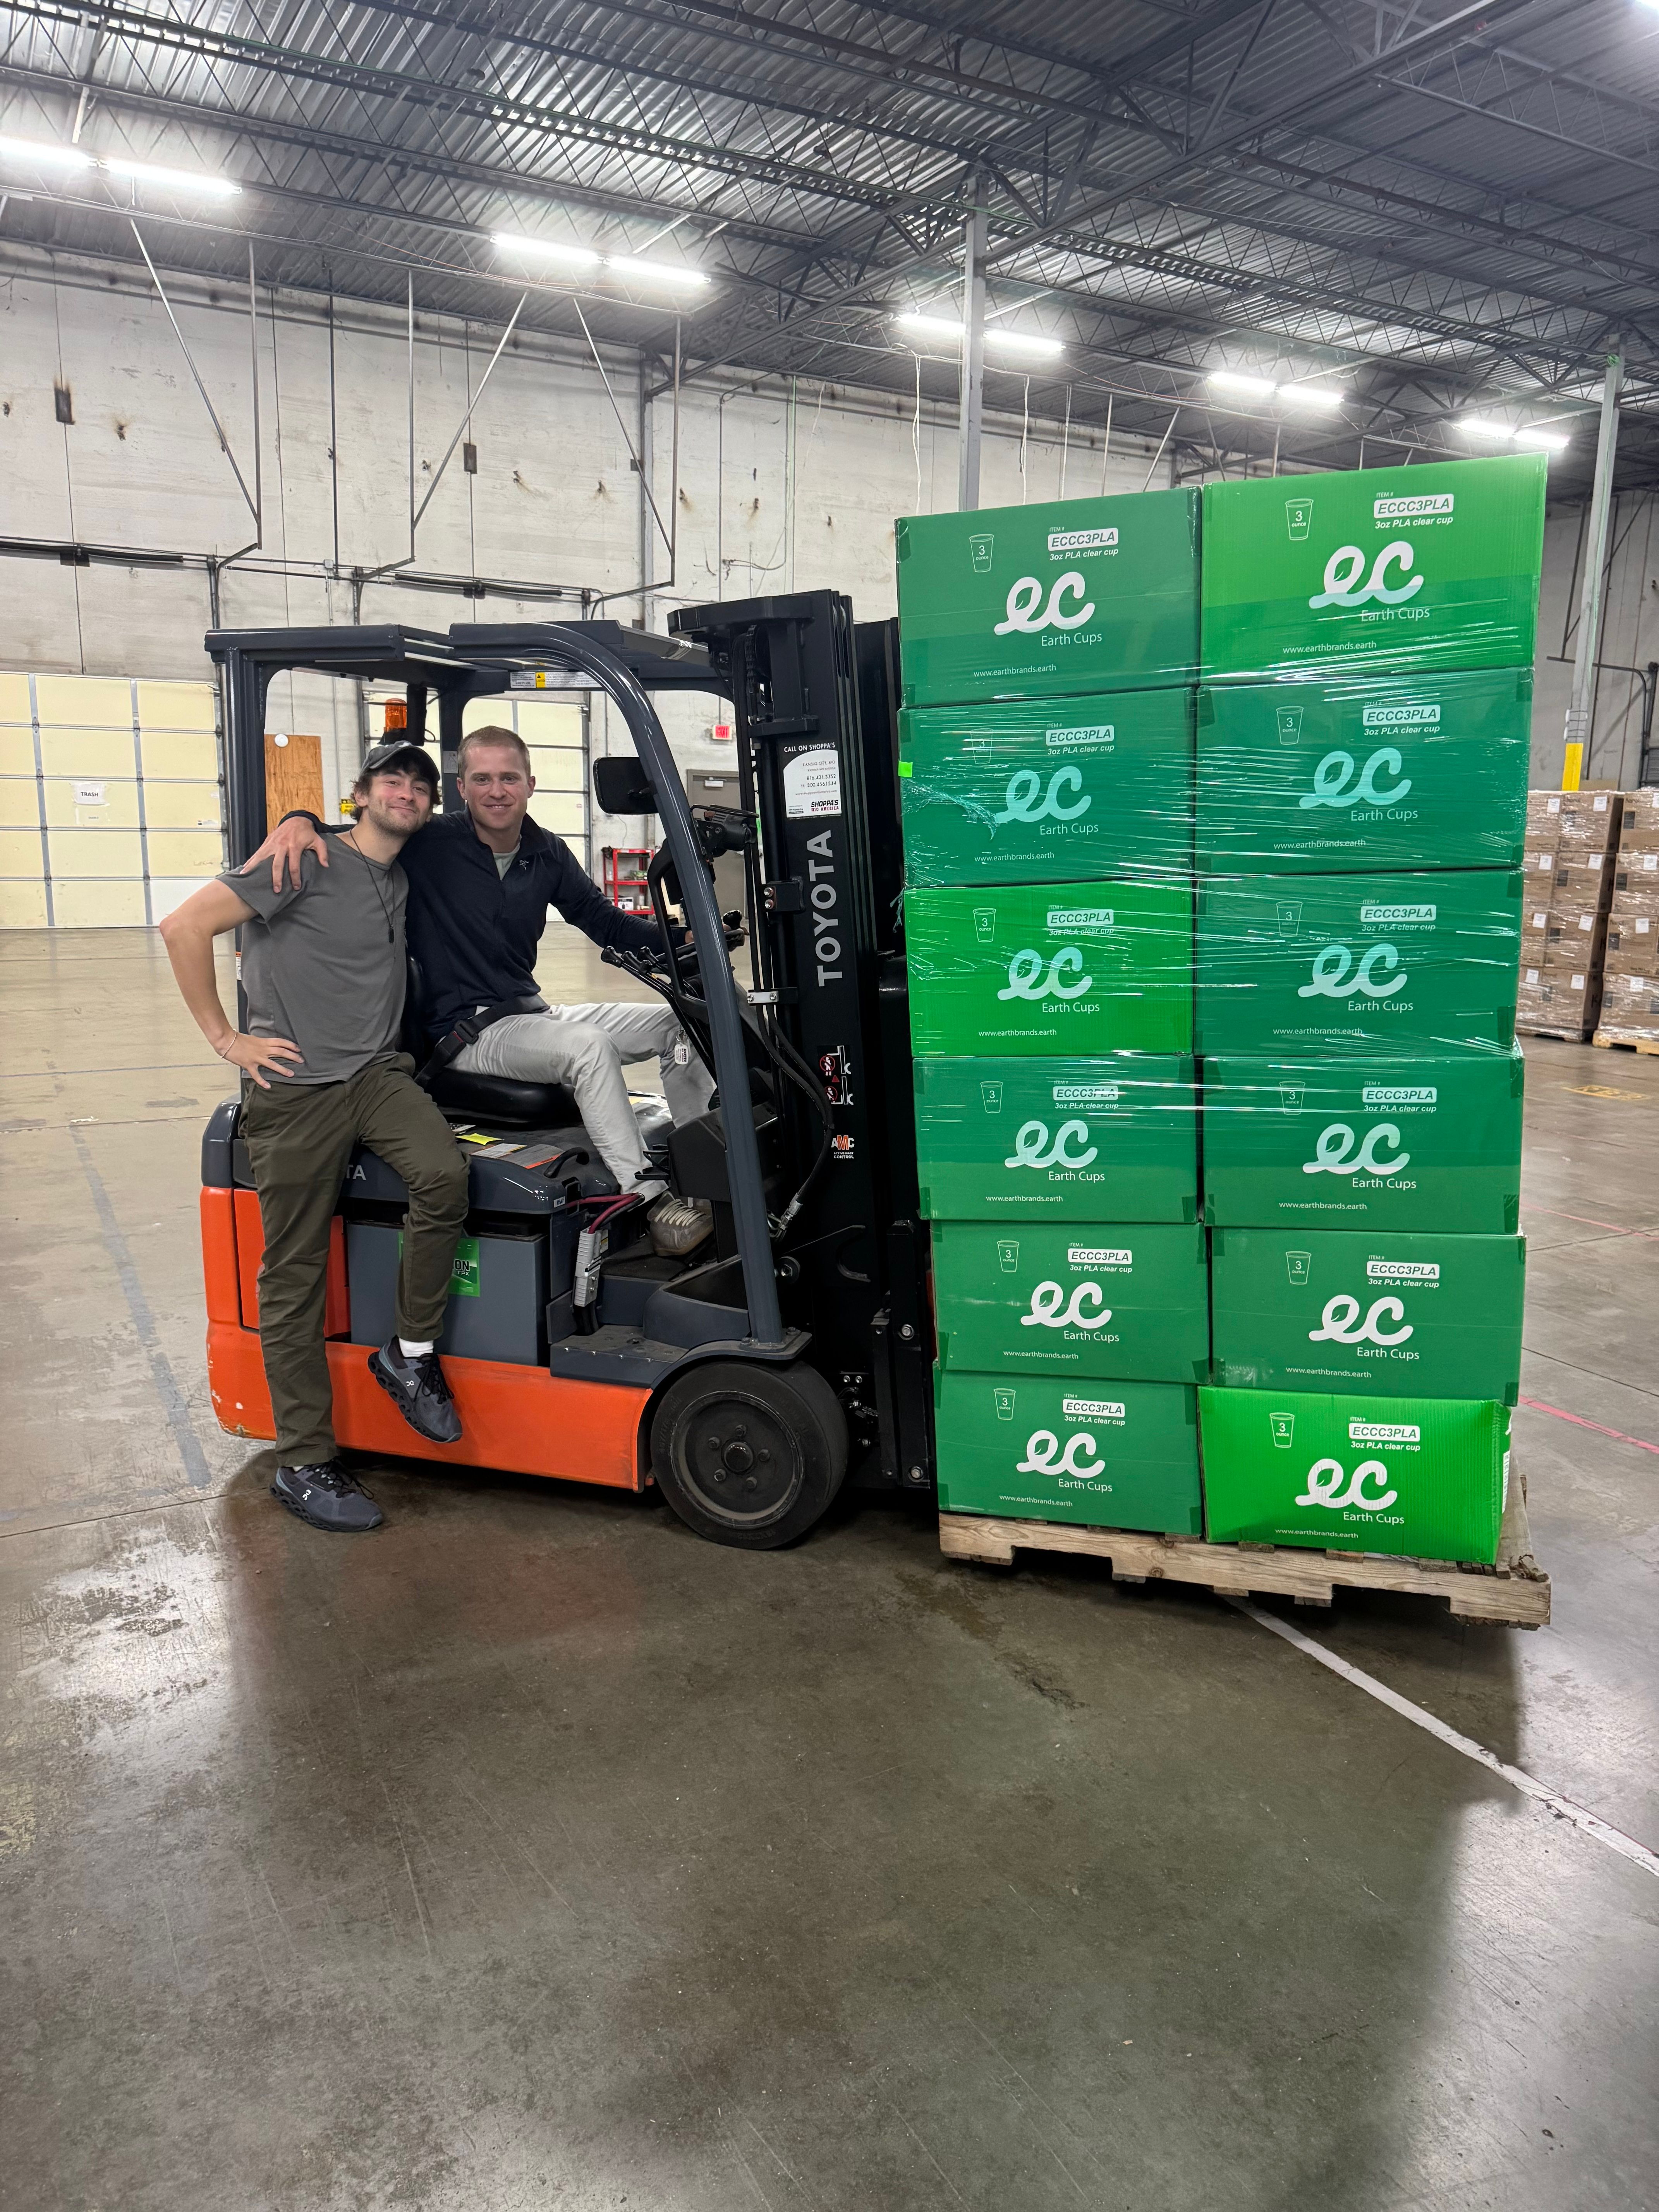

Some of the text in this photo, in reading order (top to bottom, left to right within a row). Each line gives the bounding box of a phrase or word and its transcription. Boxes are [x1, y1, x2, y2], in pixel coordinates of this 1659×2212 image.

[1378, 498, 1449, 514] ECCC3PLA
[1295, 510, 1303, 522] 3
[1375, 520, 1391, 529] 3oz
[1393, 518, 1411, 527] PLA
[1413, 517, 1435, 526] clear
[1051, 532, 1115, 547] ECCC3PLA
[979, 544, 985, 555] 3
[1065, 551, 1080, 560] PLA
[1361, 607, 1430, 622] Earth Cups
[1041, 632, 1103, 647] Earth Cups
[1283, 641, 1377, 654] www.earthbrands.earth
[973, 664, 1056, 678] www.earthbrands.earth
[1367, 708, 1436, 722] ECCC3PLA
[1286, 717, 1293, 727] 3
[1049, 729, 1111, 742] ECCC3PLA
[1381, 727, 1398, 735] PLA
[1062, 746, 1078, 754] PLA
[1351, 809, 1418, 821] Earth Cups
[1040, 823, 1099, 836] Earth Cups
[1274, 838, 1366, 850] www.earthbrands.earth
[974, 852, 1054, 862] www.earthbrands.earth
[807, 830, 843, 987] TOYOTA
[1364, 908, 1432, 919] ECCC3PLA
[982, 917, 988, 927] 3
[1051, 912, 1110, 924] ECCC3PLA
[1285, 911, 1292, 921] 3
[1042, 1002, 1100, 1013] Earth Cups
[1348, 1001, 1413, 1013] Earth Cups
[978, 1027, 1058, 1036] www.earthbrands.earth
[989, 1090, 996, 1099] 3
[1290, 1090, 1297, 1100] 3
[1366, 1091, 1432, 1099] ECCC3PLA
[831, 1135, 855, 1150] AMC
[1049, 1171, 1105, 1182] Earth Cups
[1352, 1178, 1417, 1190] Earth Cups
[1006, 1249, 1012, 1258] 3
[1072, 1252, 1128, 1261] ECCC3PLA
[453, 1259, 470, 1271] ON
[1295, 1261, 1302, 1270] 3
[1370, 1264, 1436, 1276] ECCC3PLA
[1064, 1330, 1120, 1343] Earth Cups
[1003, 1351, 1079, 1359] www.earthbrands.earth
[1357, 1347, 1420, 1361] Earth Cups
[1285, 1367, 1372, 1377] www.earthbrands.earth
[1002, 1397, 1008, 1406] 3
[1066, 1402, 1121, 1414] ECCC3PLA
[1279, 1423, 1286, 1432] 3
[1353, 1427, 1416, 1439] ECCC3PLA
[1058, 1478, 1112, 1492] Earth Cups
[999, 1495, 1073, 1506] www.earthbrands.earth
[1344, 1511, 1404, 1525] Earth Cups
[1275, 1527, 1358, 1539] www.earthbrands.earth
